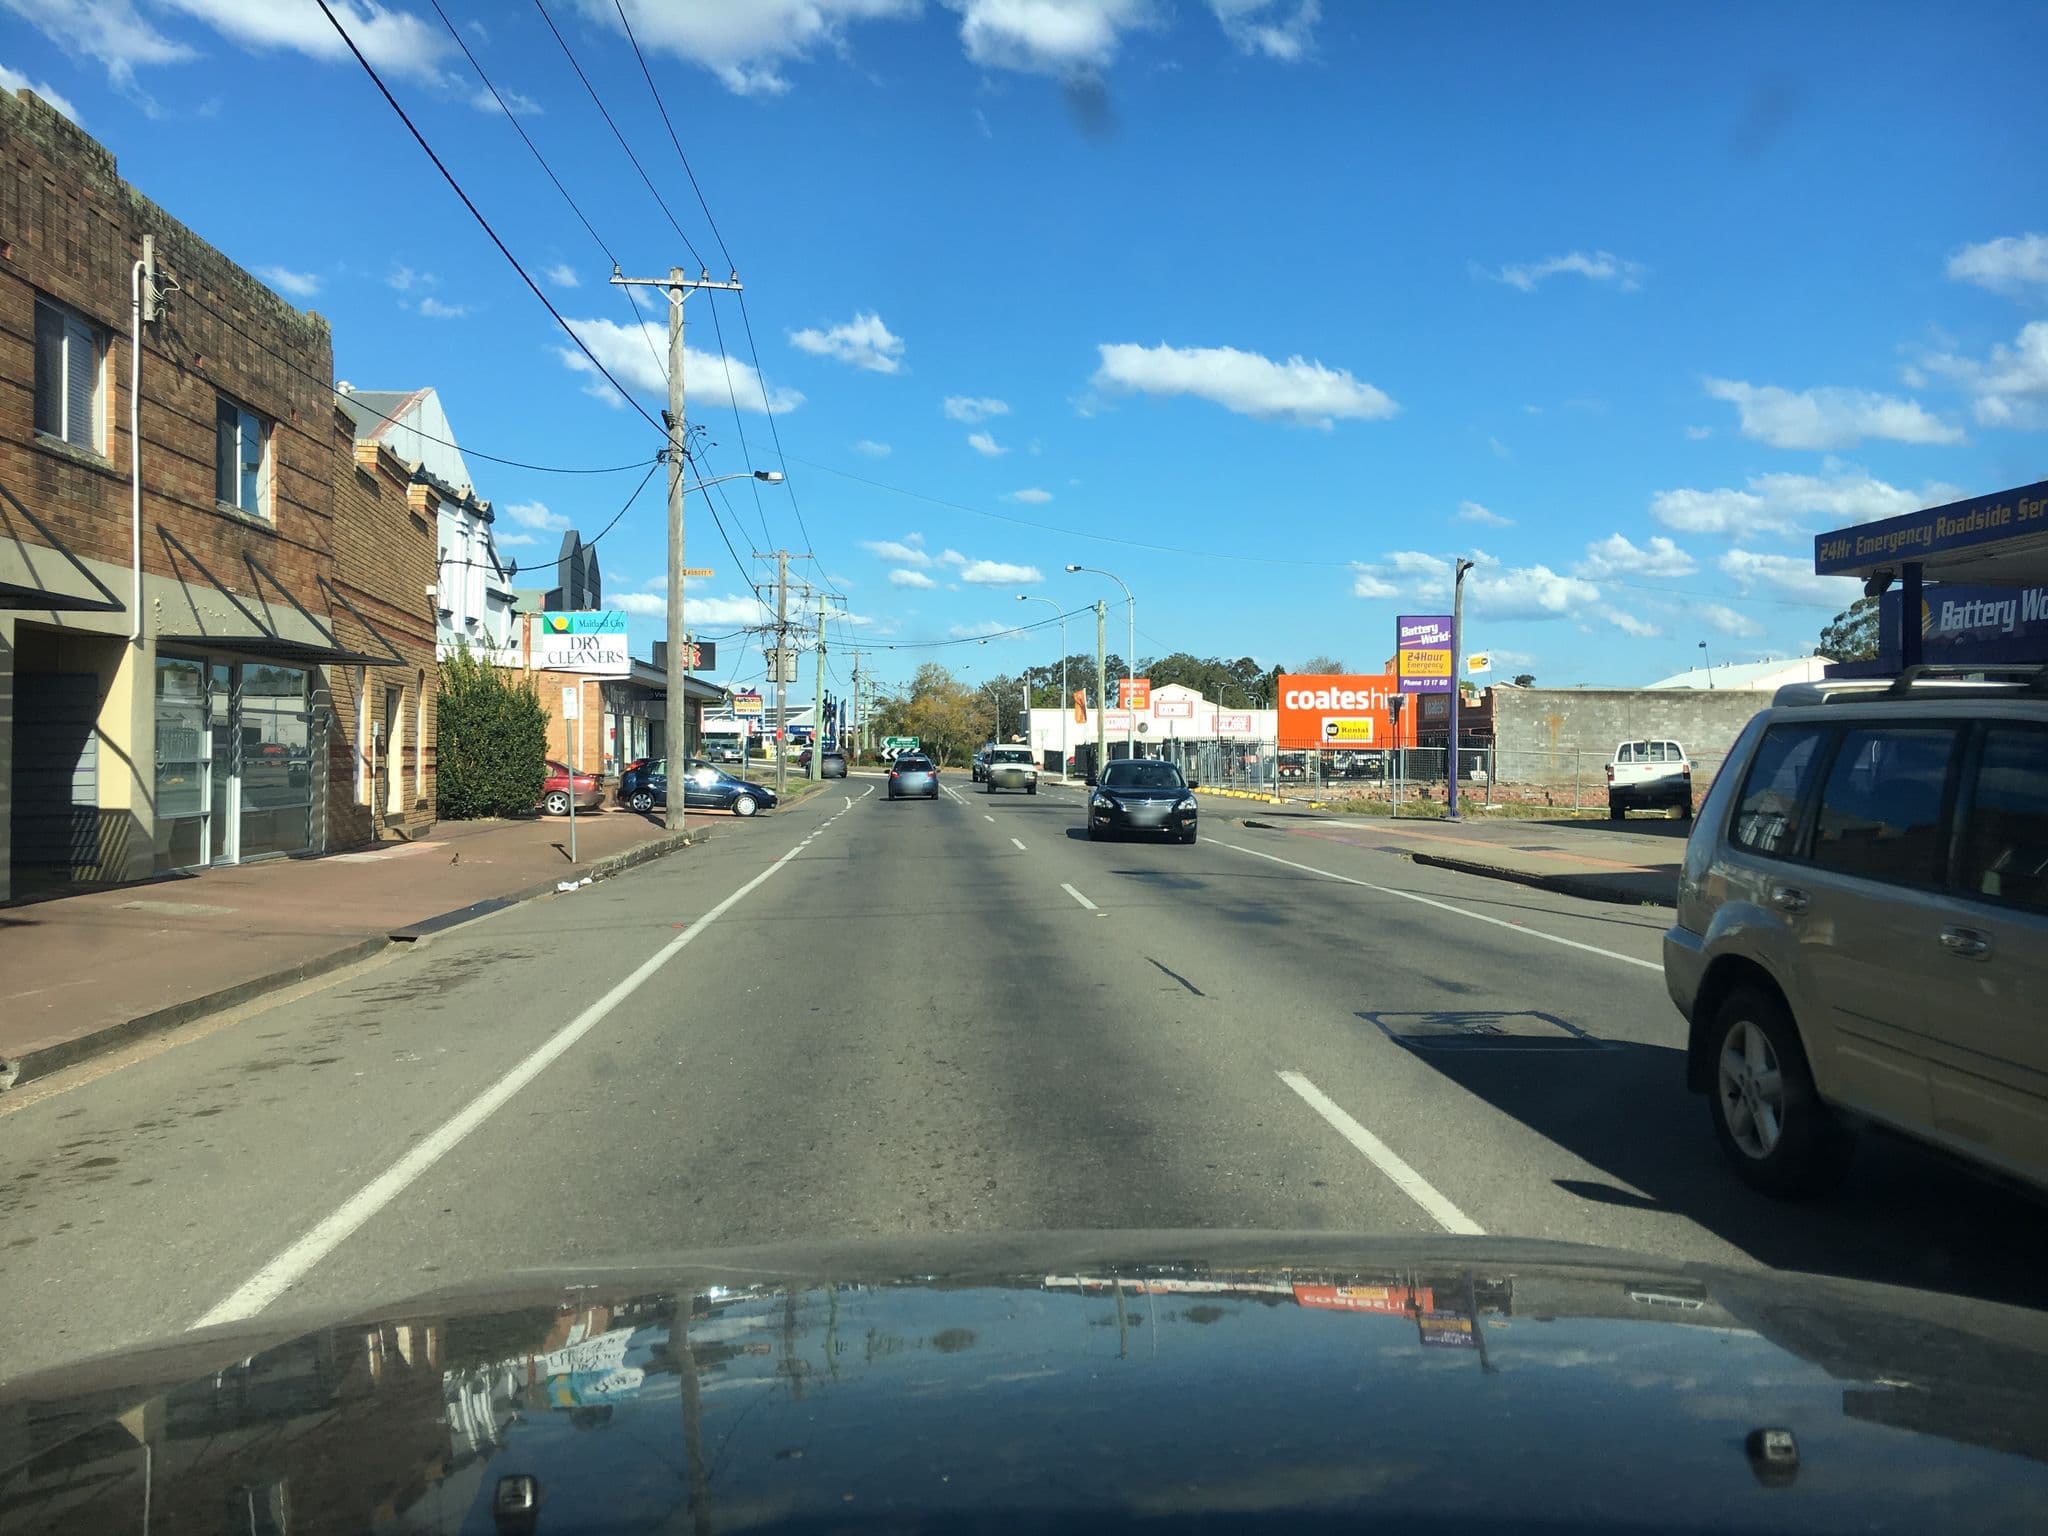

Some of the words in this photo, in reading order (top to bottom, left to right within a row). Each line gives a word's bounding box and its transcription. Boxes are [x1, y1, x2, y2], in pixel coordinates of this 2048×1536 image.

[1820, 540, 1851, 562] 24Hr
[1856, 525, 1932, 555] Emergency
[1936, 504, 2011, 539] Roadside
[1940, 599, 2017, 633] Battery
[1402, 624, 1438, 637] Battery
[570, 637, 600, 650] DRY
[1421, 631, 1449, 645] World
[548, 651, 624, 664] CLEANERS
[1407, 652, 1444, 661] 24Hour
[1407, 662, 1444, 670] Emergency
